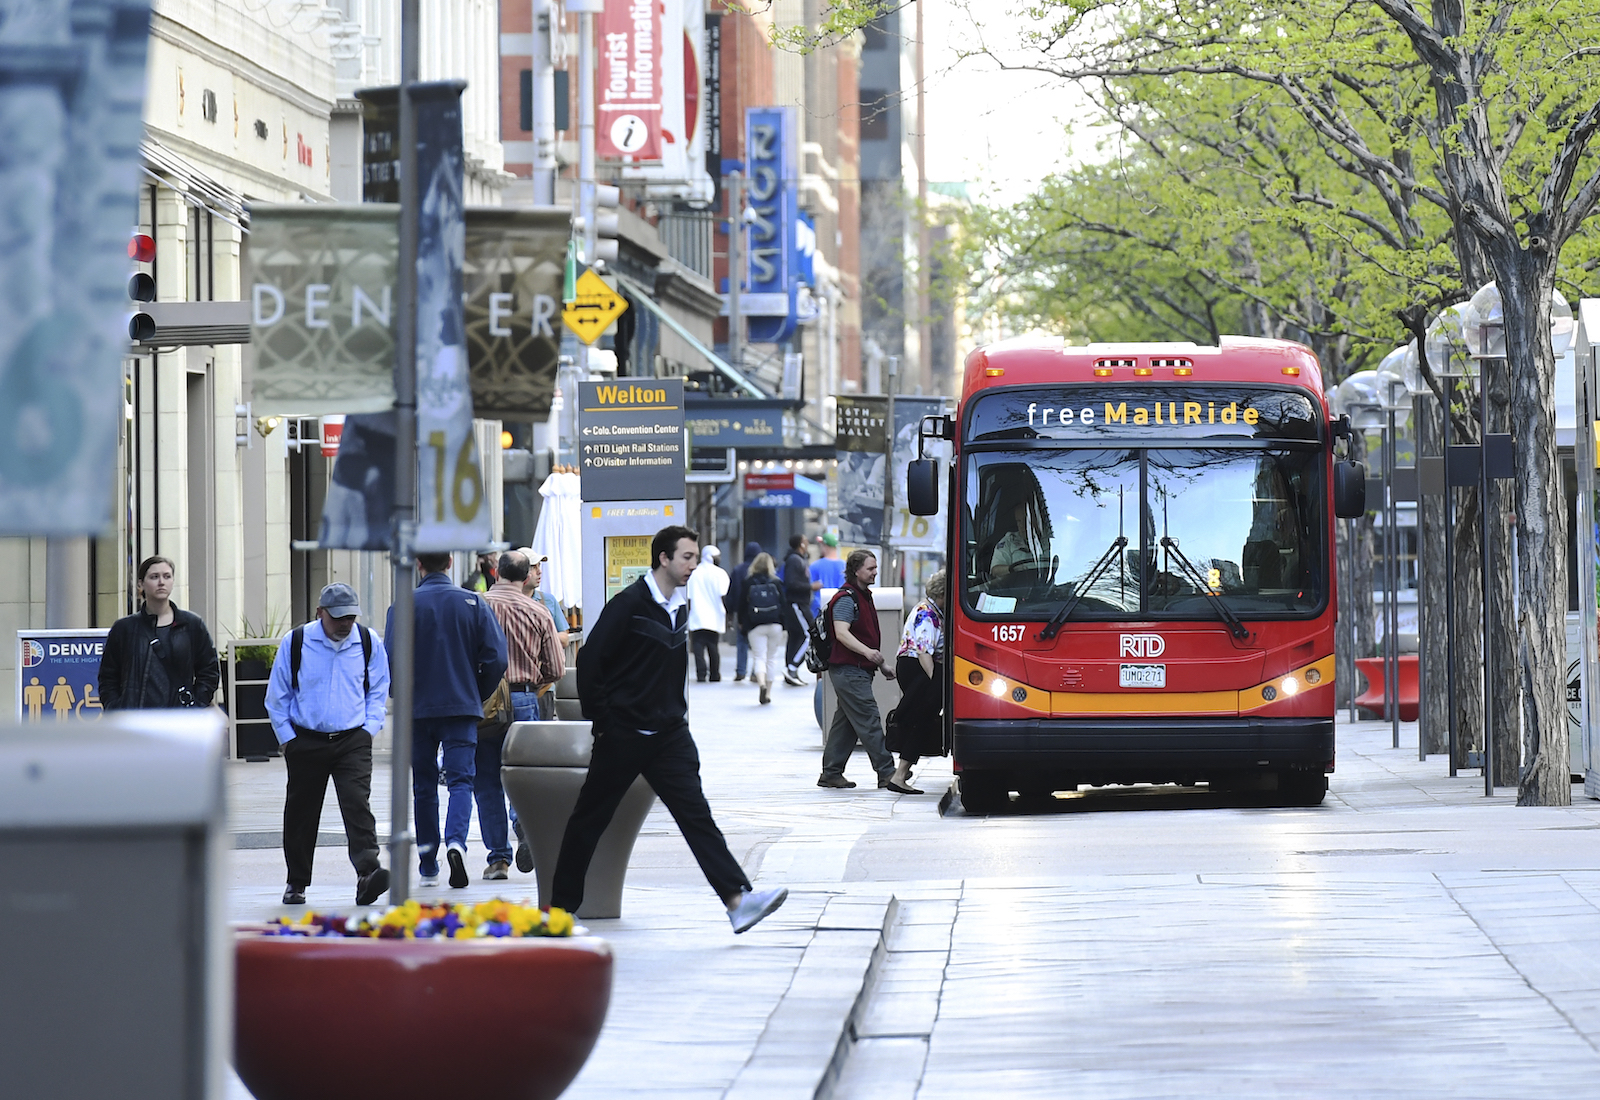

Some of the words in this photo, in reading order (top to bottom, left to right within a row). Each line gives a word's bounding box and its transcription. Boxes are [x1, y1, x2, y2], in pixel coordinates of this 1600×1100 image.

[606, 32, 628, 100] Tourist
[751, 124, 777, 283] ROSS
[596, 385, 666, 404] Welton
[838, 408, 870, 417] 16TH
[1027, 403, 1095, 425] free
[1104, 402, 1259, 425] MallRide
[838, 418, 885, 427] STREET
[592, 426, 611, 436] Colo.
[612, 424, 653, 435] Convention
[654, 424, 679, 434] Center
[838, 428, 871, 437] MALL
[593, 444, 610, 454] RTD
[611, 444, 630, 455] Light
[632, 443, 646, 453] Rail
[647, 443, 679, 453] Stations
[603, 457, 627, 467] Visitor
[629, 456, 672, 466] Information
[429, 430, 482, 523] 16
[606, 508, 625, 517] FREE
[899, 508, 929, 538] 16
[991, 625, 1026, 641] 1657
[49, 643, 104, 656] DENVE
[1119, 634, 1165, 657] RTD
